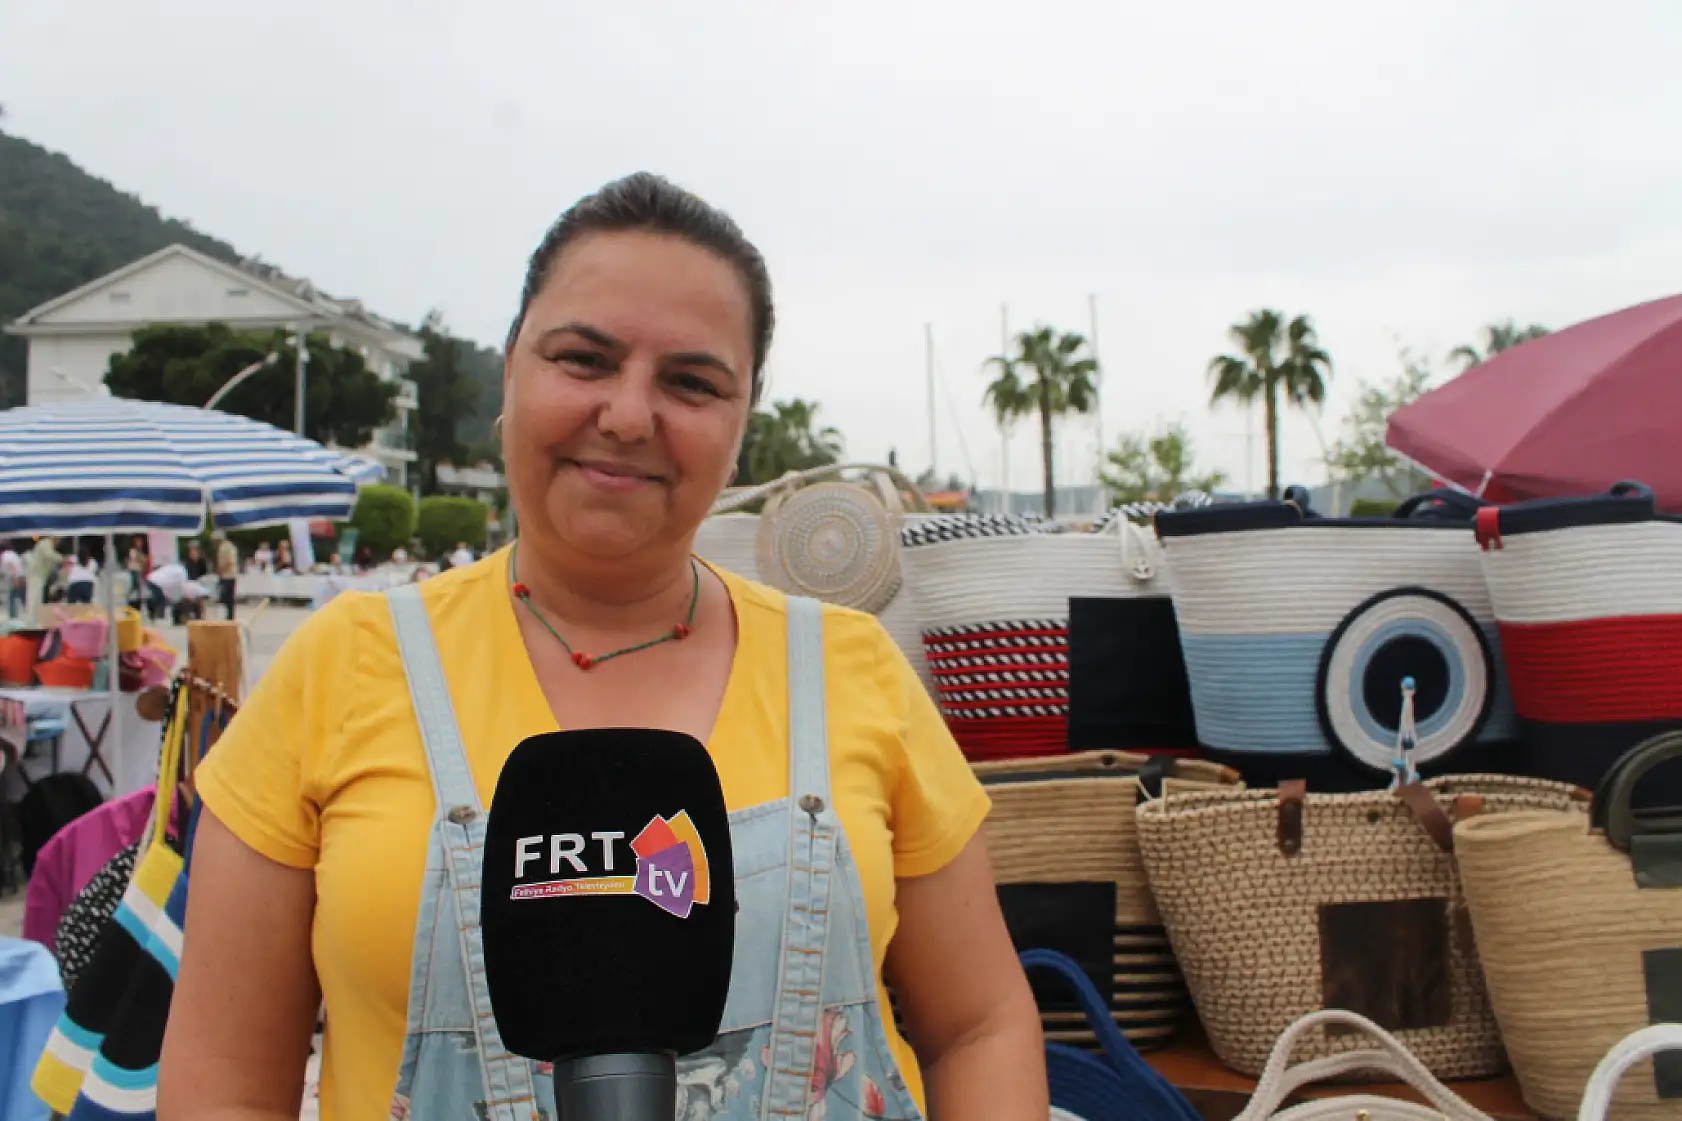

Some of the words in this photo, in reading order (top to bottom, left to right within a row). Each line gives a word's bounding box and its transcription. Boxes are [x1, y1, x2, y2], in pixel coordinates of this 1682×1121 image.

[515, 832, 625, 878] FRT
[546, 885, 573, 894] Radyo
[648, 863, 688, 897] tv
